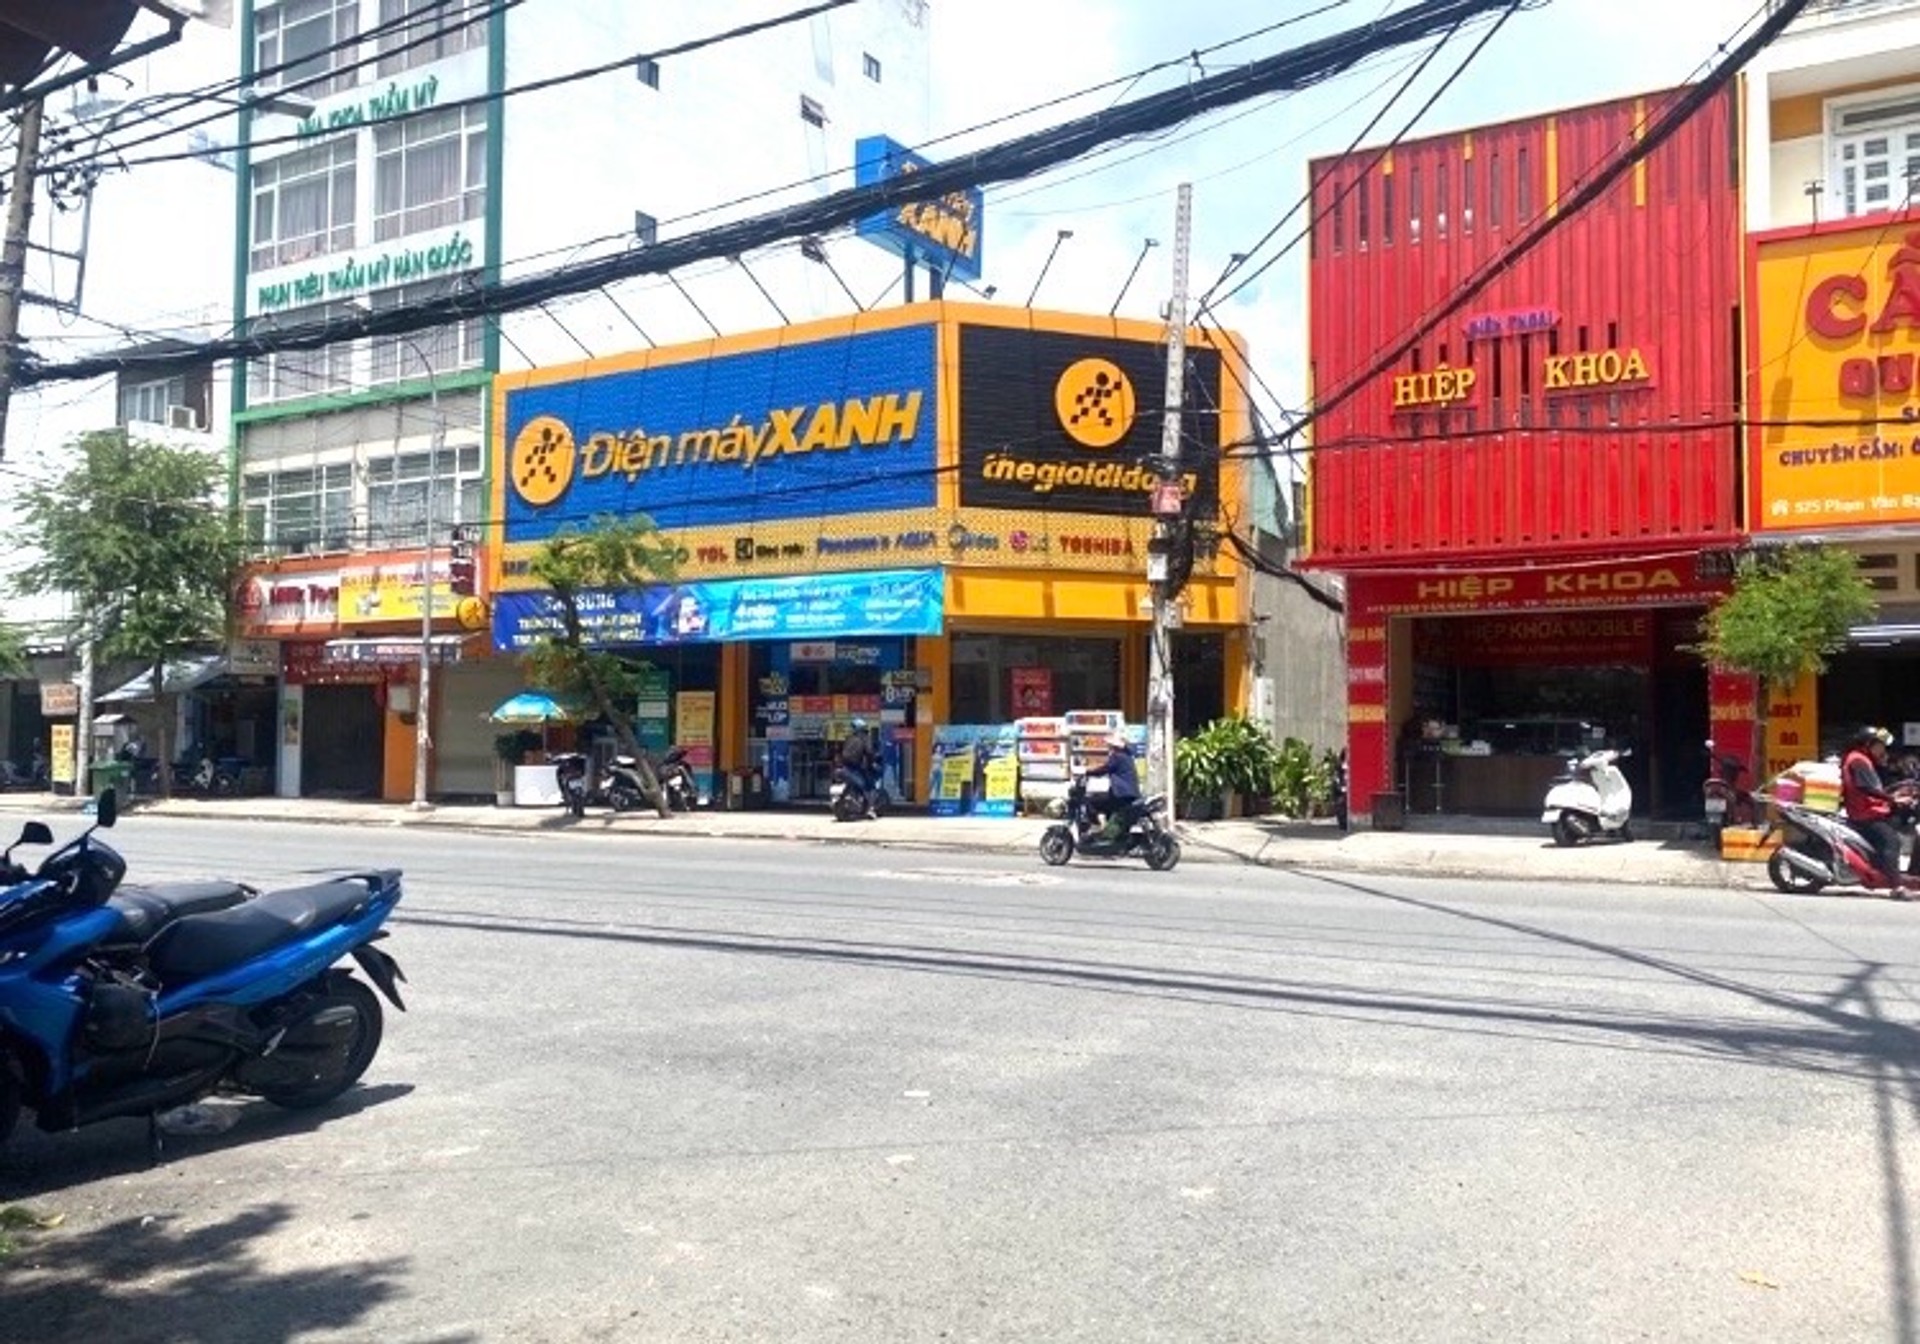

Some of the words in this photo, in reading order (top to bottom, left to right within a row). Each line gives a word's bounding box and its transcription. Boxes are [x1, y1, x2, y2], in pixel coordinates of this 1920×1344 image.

[1393, 362, 1478, 407] HIỆP
[1543, 347, 1650, 389] KHOA
[1779, 443, 1855, 466] CHUYÊN
[1059, 535, 1133, 556] TOSHIBA
[1417, 574, 1514, 602] HIỆP
[1544, 570, 1681, 594] KHOA
